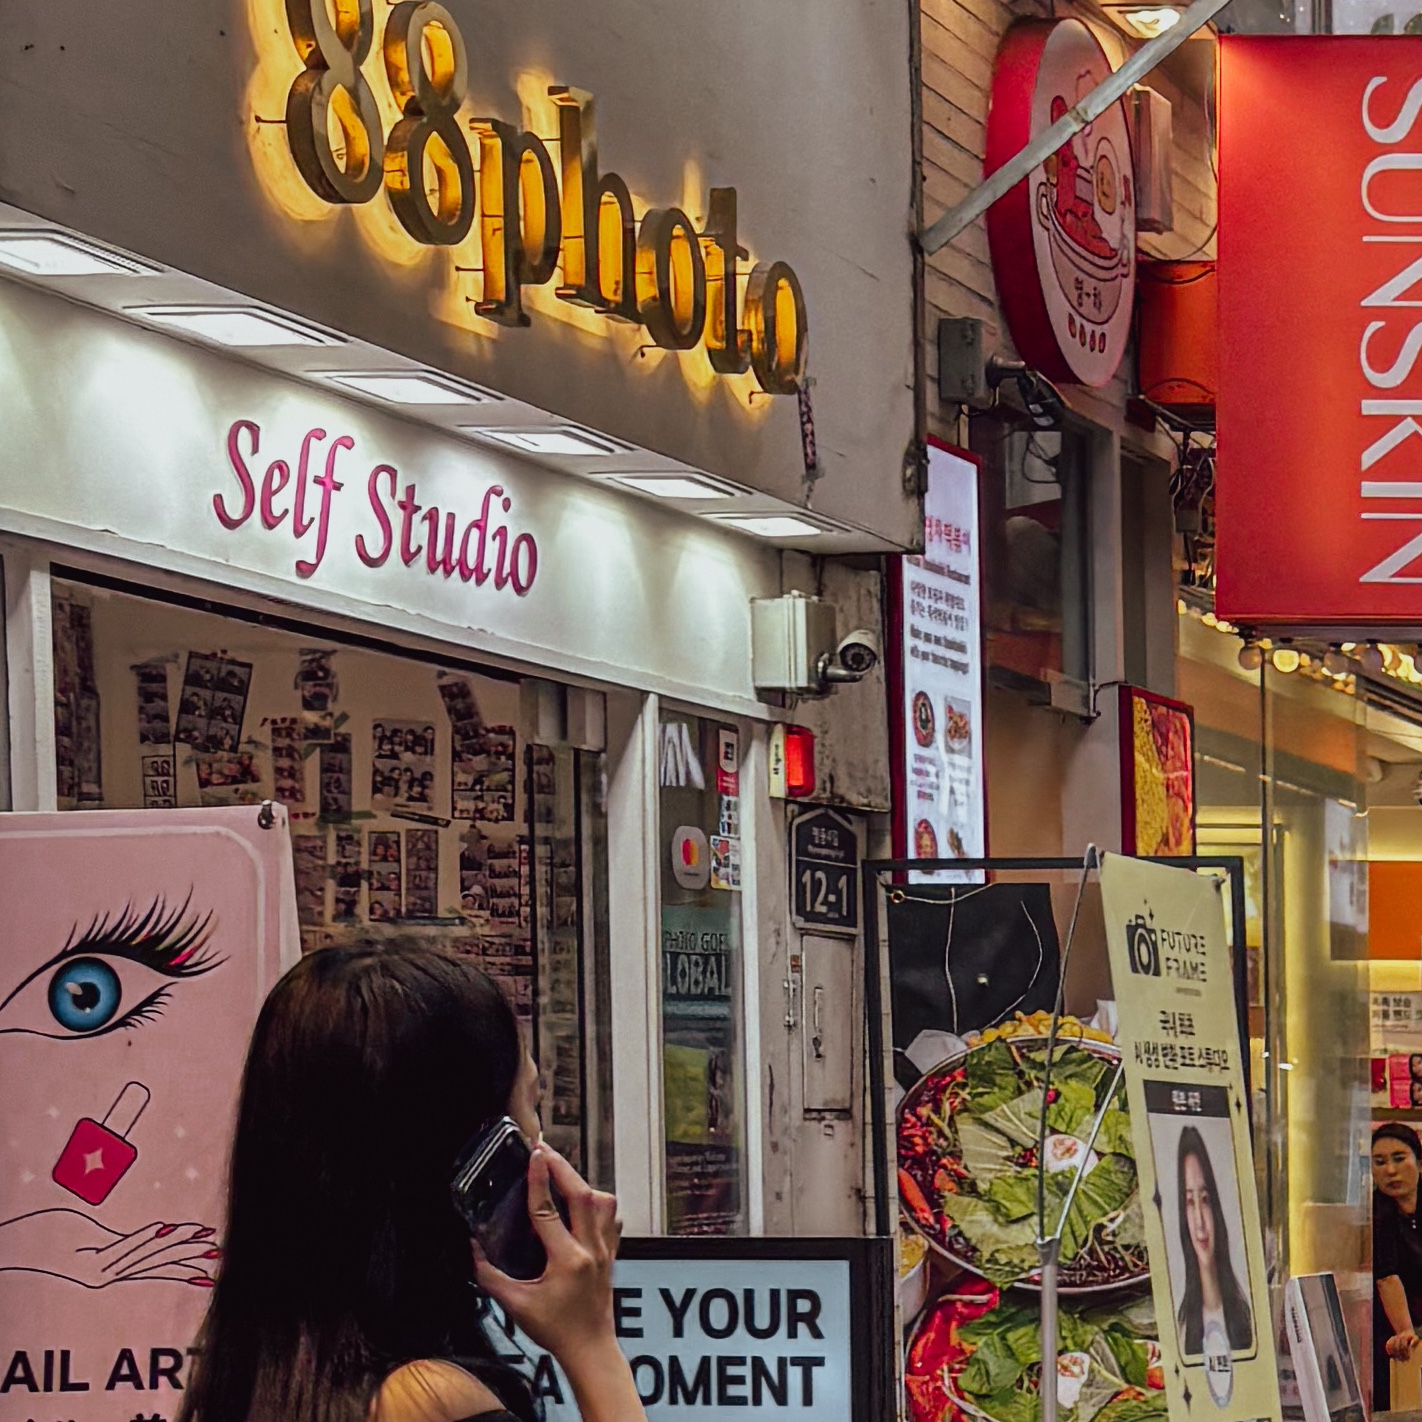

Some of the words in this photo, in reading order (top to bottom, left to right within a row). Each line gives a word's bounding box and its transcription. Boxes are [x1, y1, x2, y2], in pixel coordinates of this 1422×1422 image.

[287, 0, 806, 395] 88photo
[213, 420, 353, 579] Self
[355, 464, 539, 597] Studio
[802, 868, 848, 917] 12-1
[1160, 929, 1207, 956] FUTURE
[1166, 957, 1207, 982] FRAME
[659, 1287, 825, 1340] YOUR
